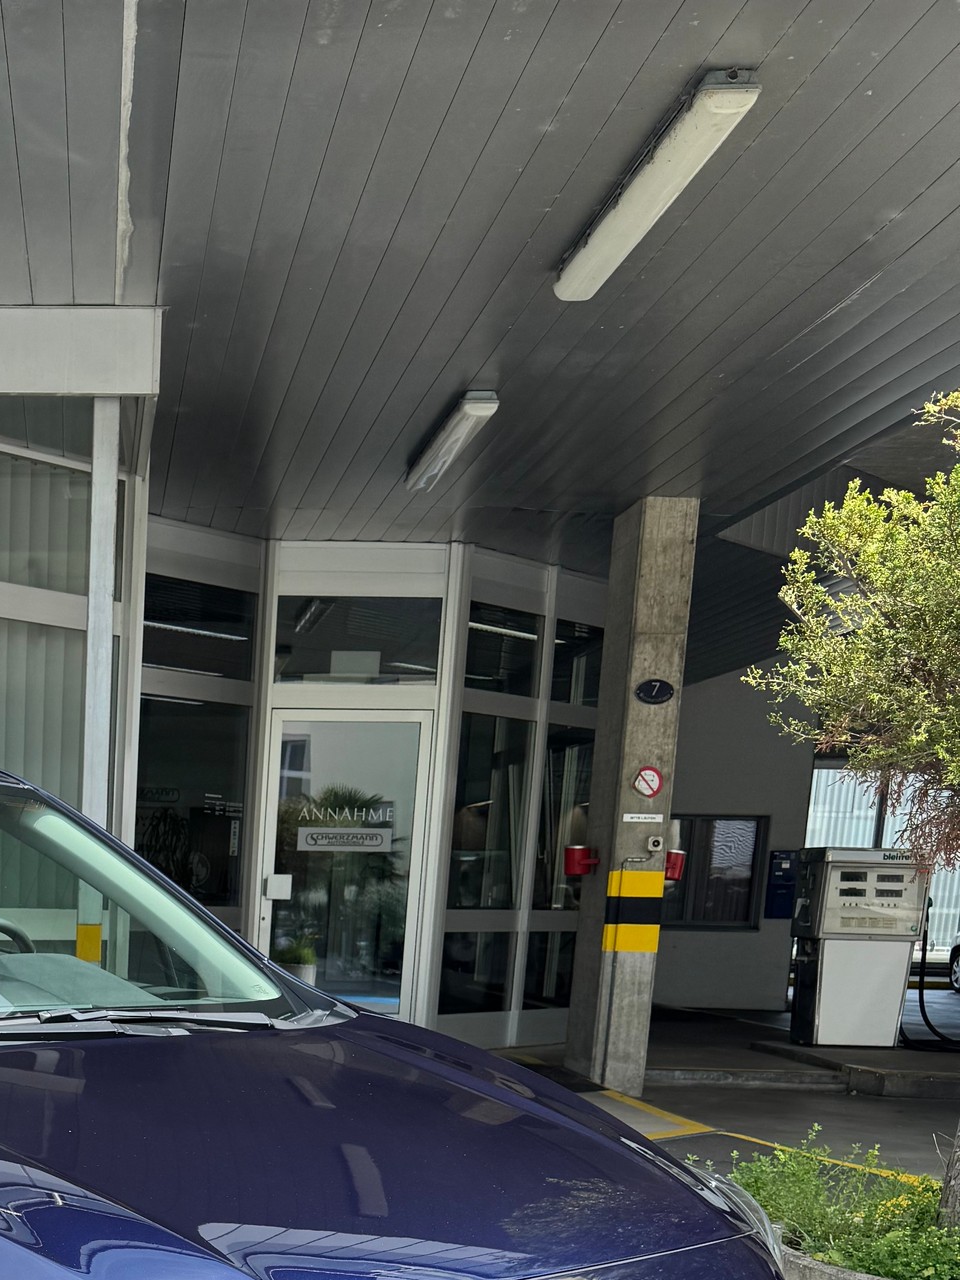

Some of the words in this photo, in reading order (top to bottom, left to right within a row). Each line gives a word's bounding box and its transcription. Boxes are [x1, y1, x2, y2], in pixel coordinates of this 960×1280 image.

[651, 682, 660, 696] 7
[298, 807, 394, 822] ANNAHME
[310, 832, 378, 846] SCHWERZMANN
